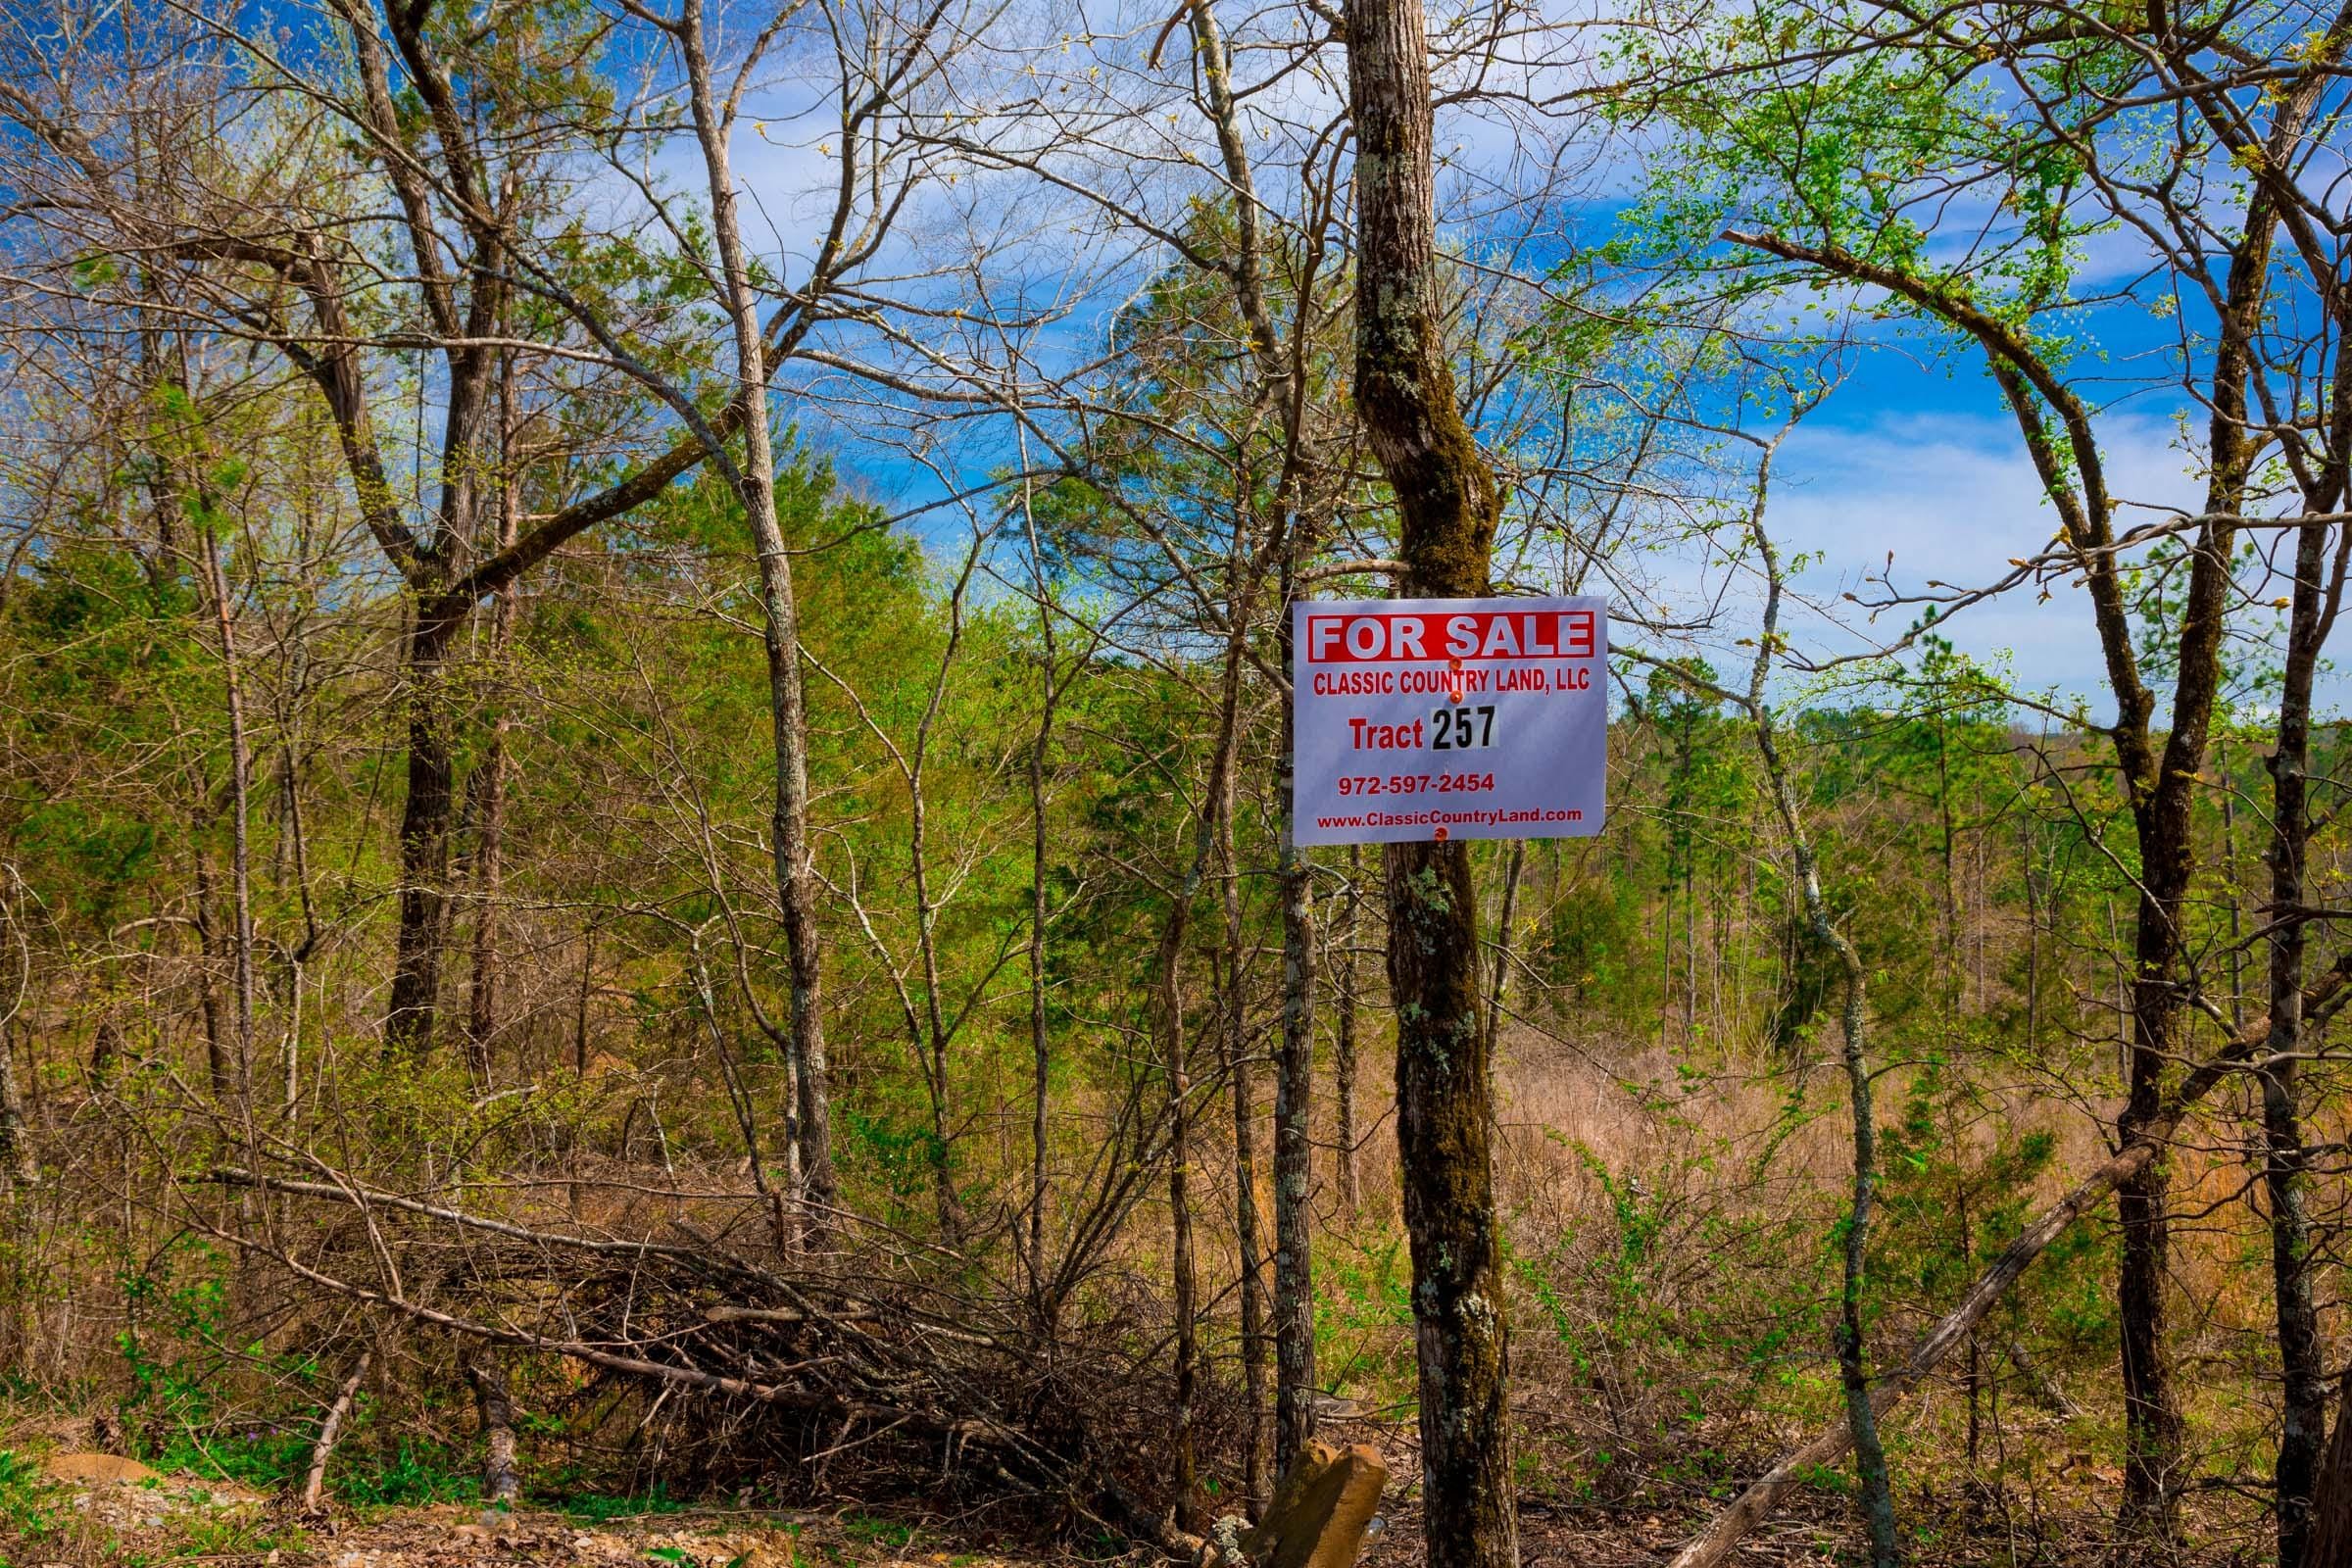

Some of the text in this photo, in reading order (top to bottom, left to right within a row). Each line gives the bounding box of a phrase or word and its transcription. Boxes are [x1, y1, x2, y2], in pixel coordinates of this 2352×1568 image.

[1312, 614, 1591, 660] FOR SALE
[1313, 667, 1590, 698] CLASSIC COUNTRY LAND, LLC
[1348, 706, 1495, 750] Tract 257
[1339, 773, 1494, 795] 972-597-2454
[1317, 808, 1582, 829] www.ClassicCountryLand.com
